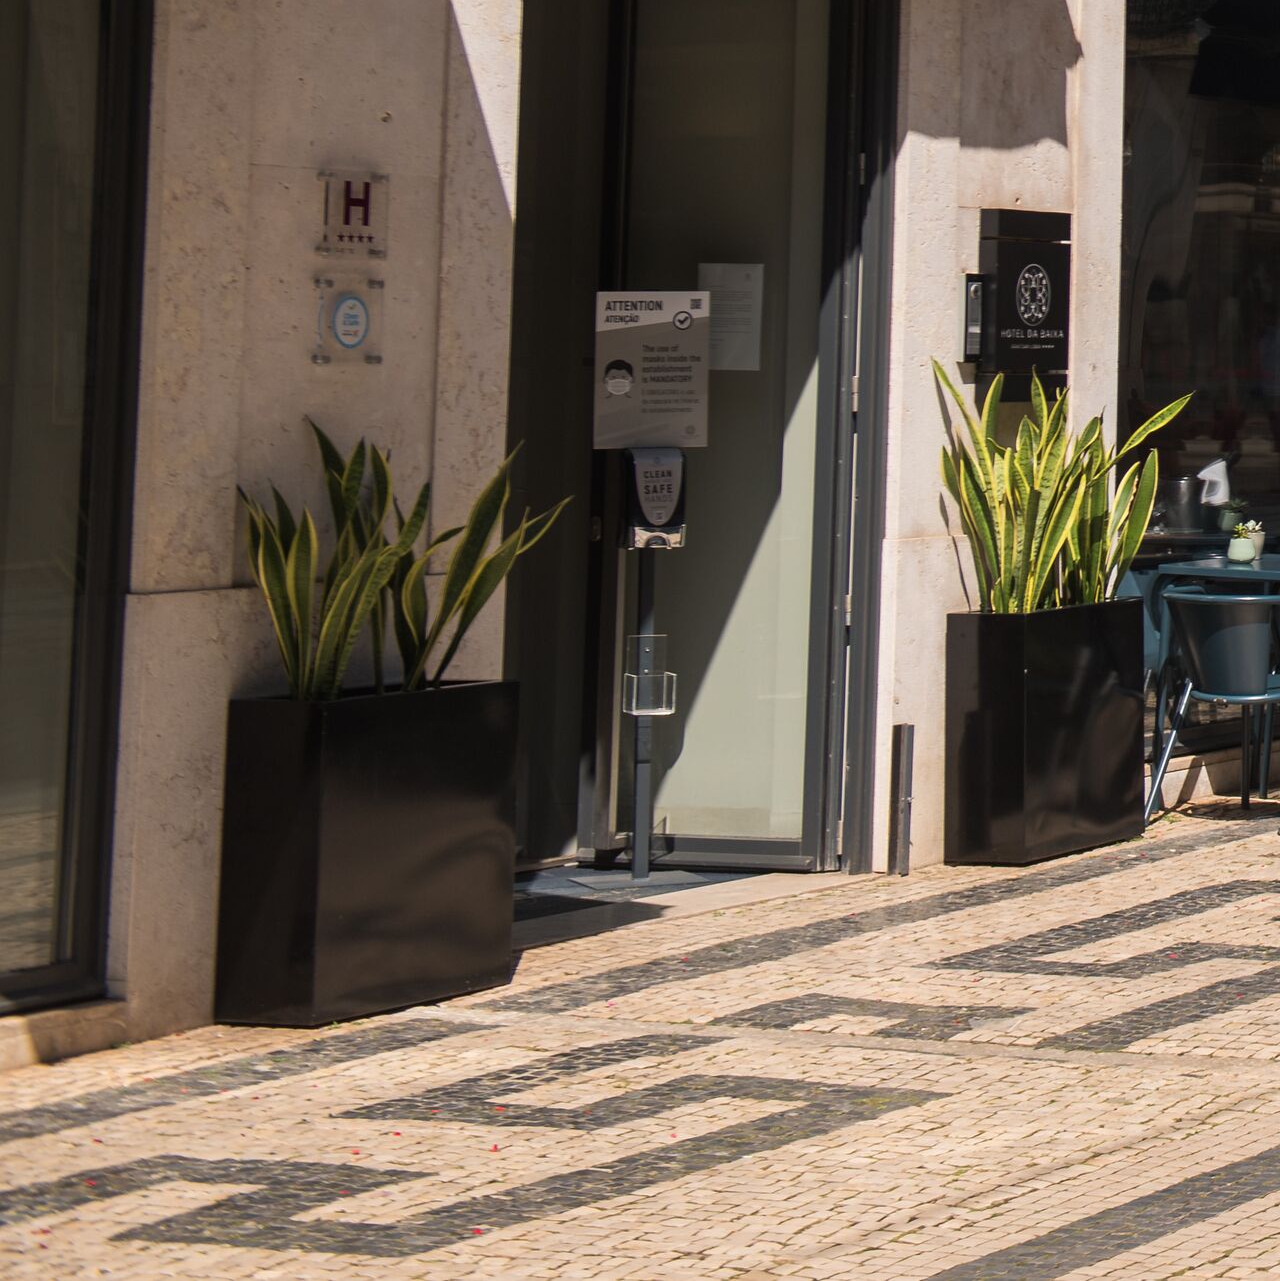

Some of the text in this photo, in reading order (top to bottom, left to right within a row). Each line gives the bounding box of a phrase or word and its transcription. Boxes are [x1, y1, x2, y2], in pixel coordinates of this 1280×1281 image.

[343, 181, 371, 226] H
[605, 300, 664, 311] ATTENTION
[604, 313, 640, 325] ATENÇÃO
[1001, 329, 1064, 338] HOTEL DA BAIXA
[642, 344, 655, 352] The
[689, 355, 701, 363] the
[649, 375, 692, 383] MANDATORY
[643, 470, 672, 479] CLEAN
[644, 484, 673, 494] SAFE
[644, 495, 673, 503] HANDS
